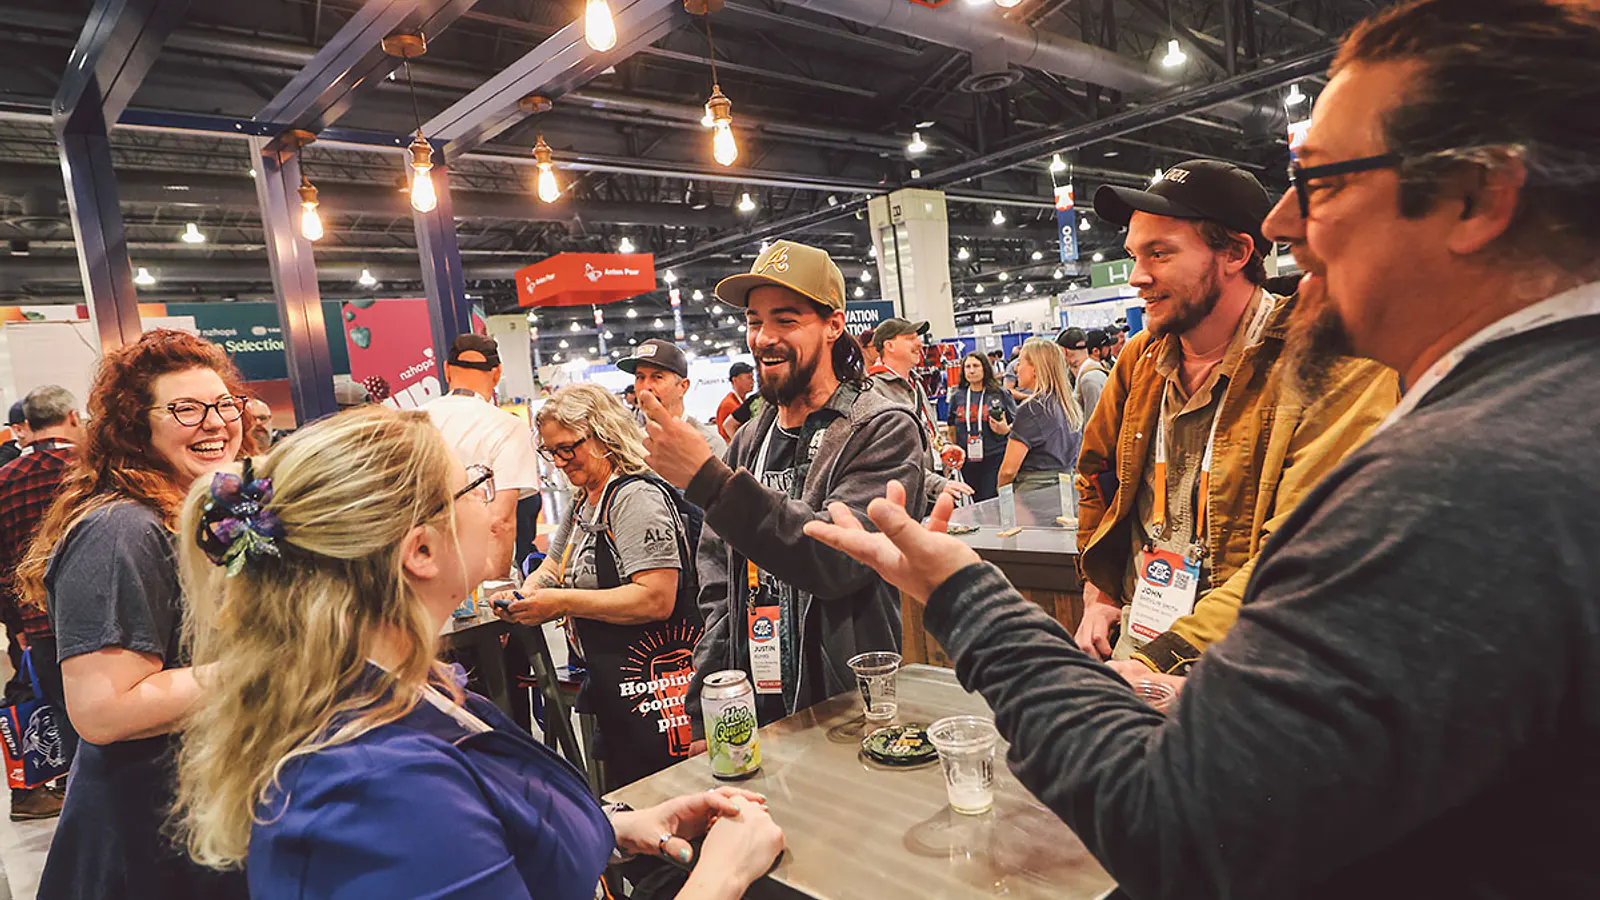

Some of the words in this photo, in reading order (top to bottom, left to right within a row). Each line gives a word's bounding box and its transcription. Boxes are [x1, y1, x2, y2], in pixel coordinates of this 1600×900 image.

[1062, 225, 1074, 258] 1200
[1108, 263, 1128, 283] H
[400, 359, 434, 380] nzhops
[644, 528, 674, 544] ALS
[1141, 587, 1162, 599] JOHN
[754, 645, 776, 653] JUSTIN
[723, 705, 748, 723] Hop
